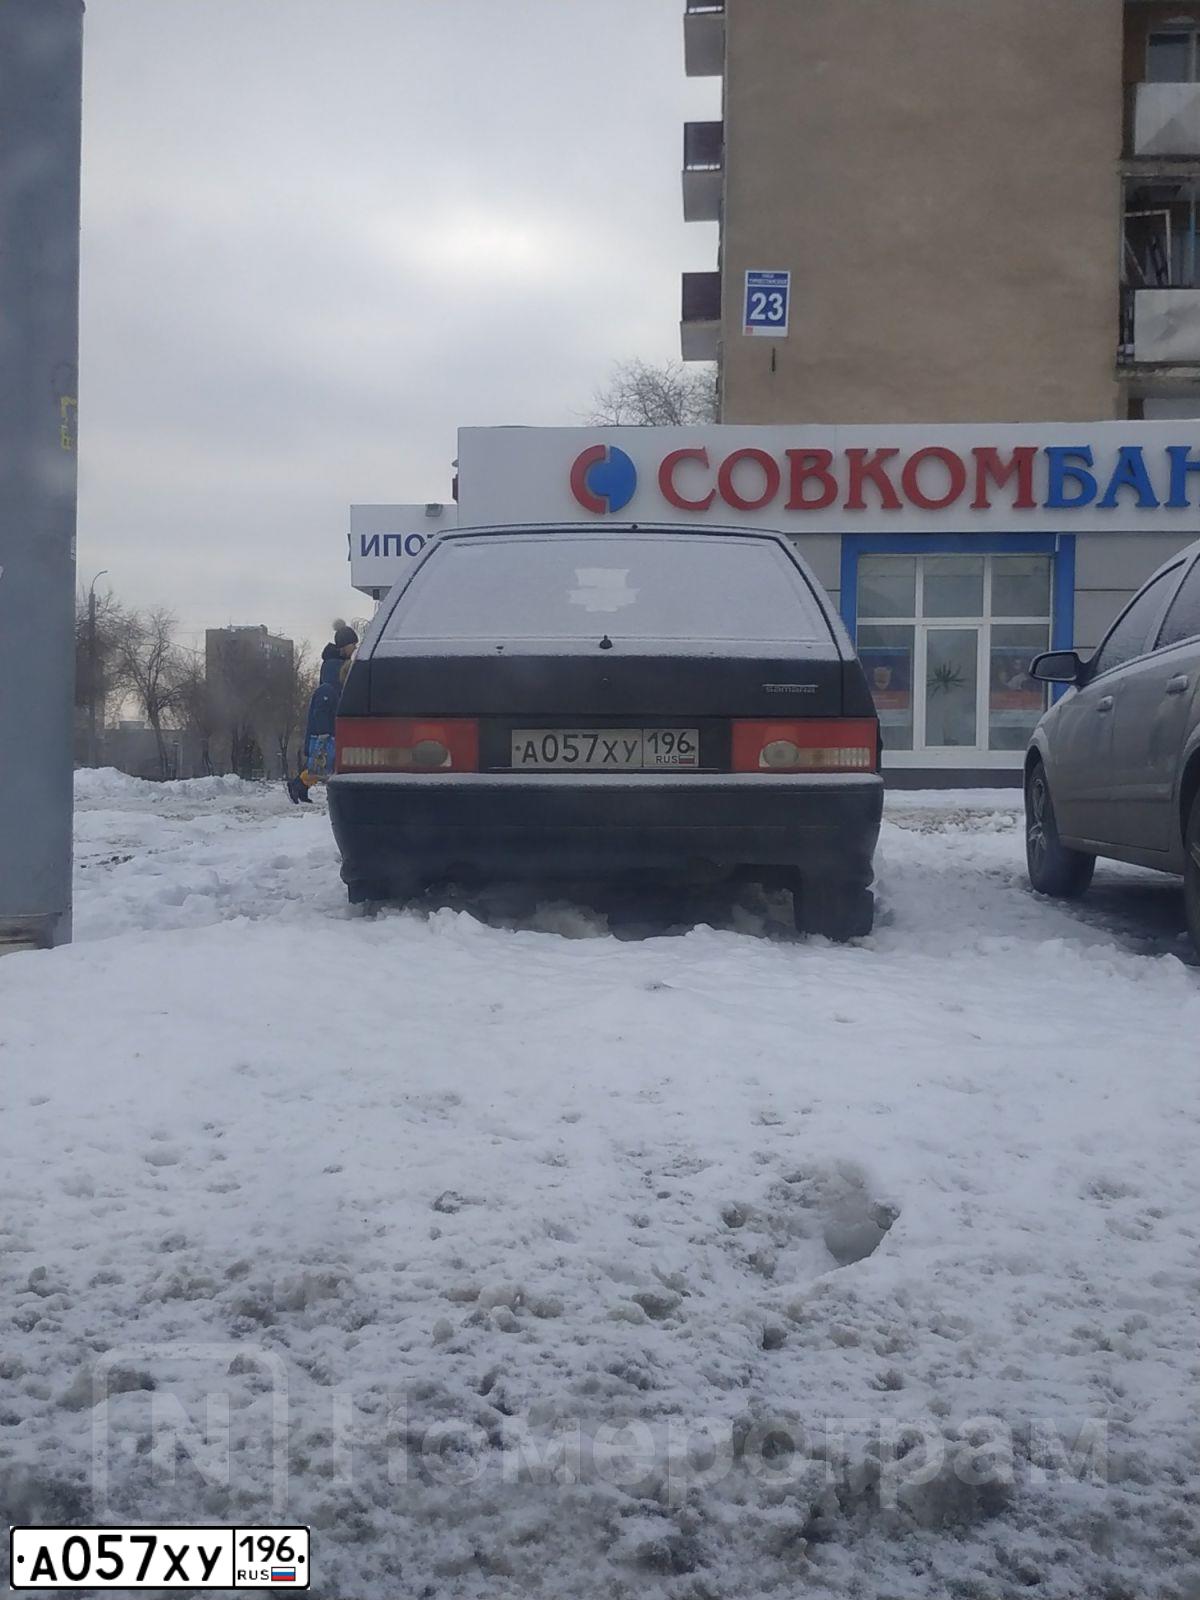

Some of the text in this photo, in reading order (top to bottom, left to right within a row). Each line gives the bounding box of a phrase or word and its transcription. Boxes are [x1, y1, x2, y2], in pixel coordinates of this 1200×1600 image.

[750, 292, 783, 321] 23
[657, 445, 1200, 512] СОВКОМБАН
[360, 533, 434, 557] ИПО
[522, 732, 690, 763] А057ХУ 196
[656, 755, 678, 764] RUS
